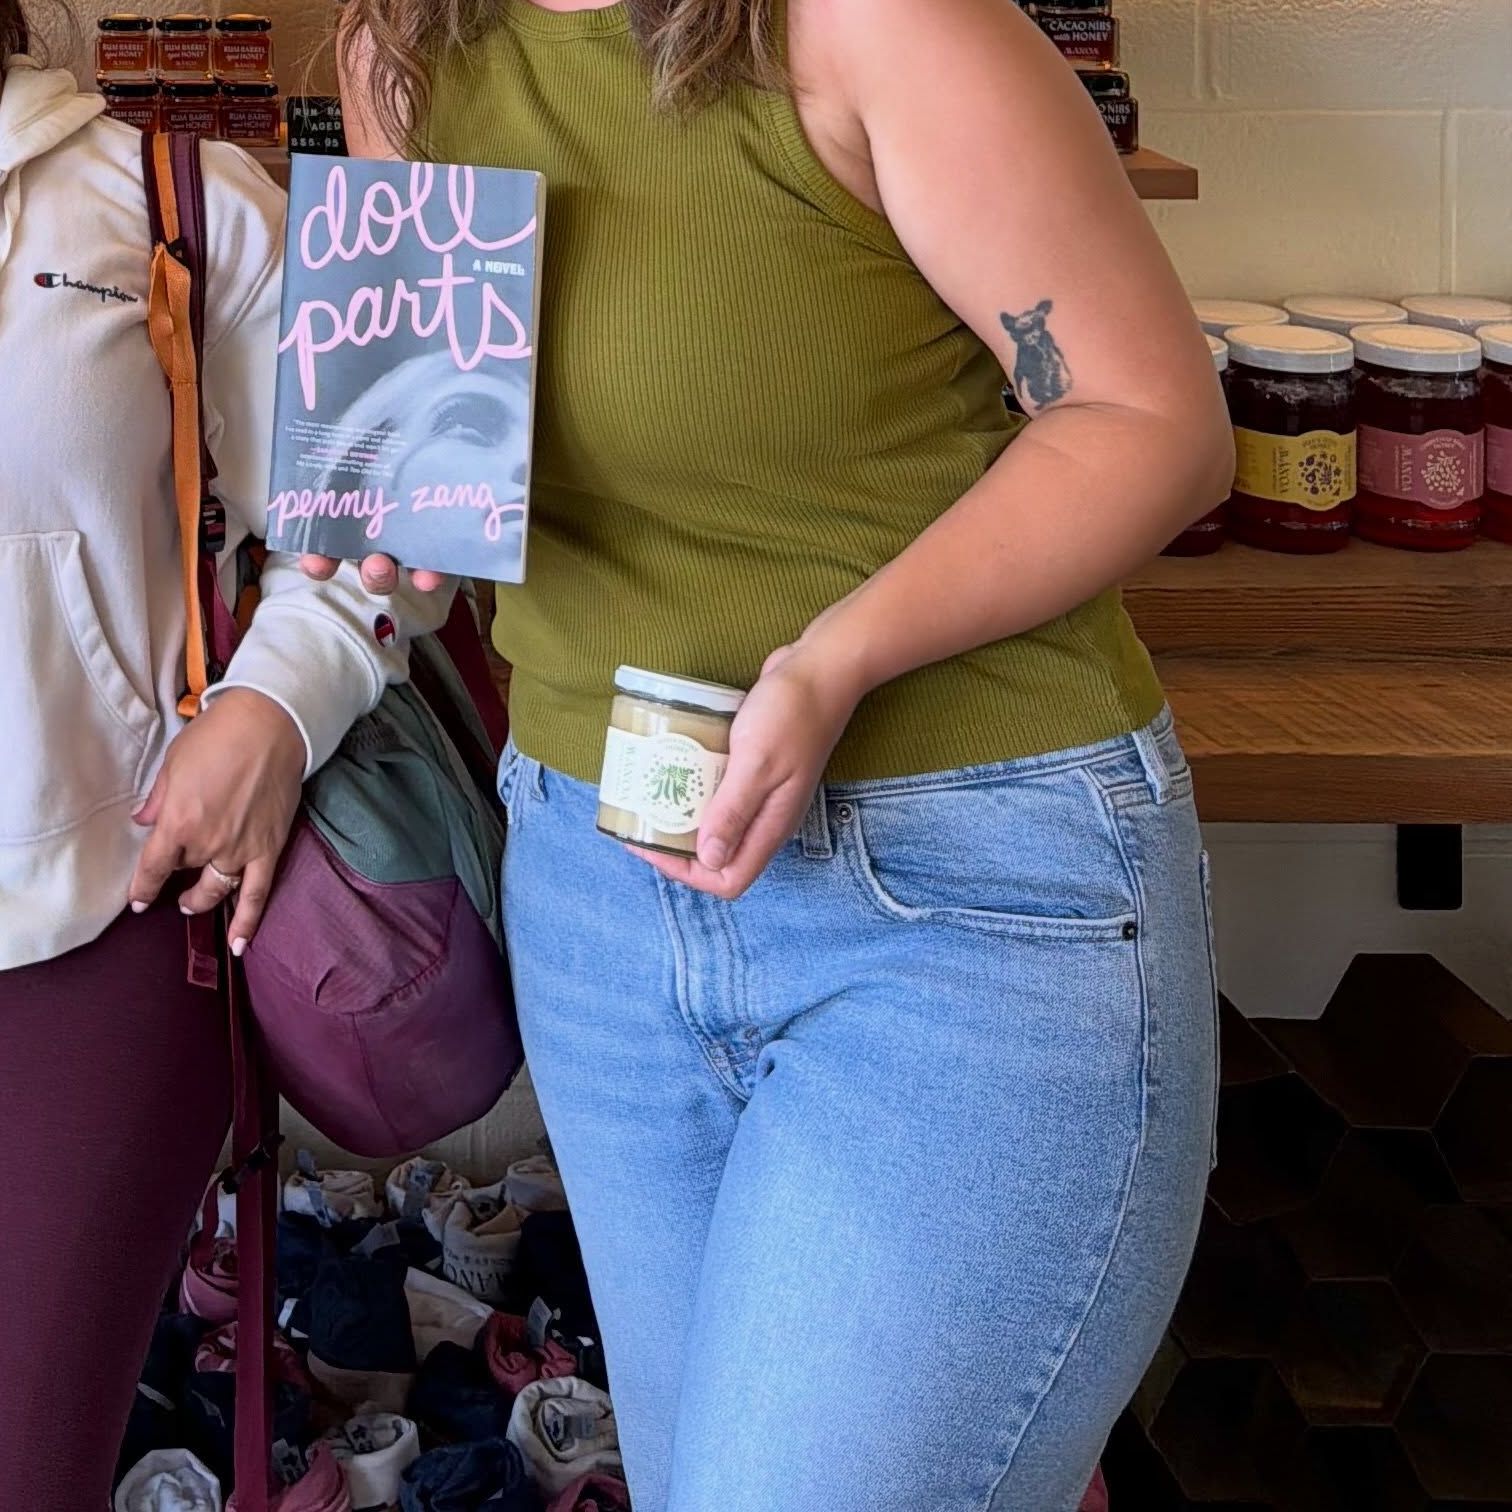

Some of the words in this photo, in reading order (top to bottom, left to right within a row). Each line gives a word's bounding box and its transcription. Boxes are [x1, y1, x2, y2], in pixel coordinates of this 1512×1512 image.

[1049, 20, 1086, 31] CACAO
[1088, 20, 1112, 31] NIBS
[1072, 31, 1108, 41] HONEY
[119, 43, 144, 51] BARREL
[1110, 103, 1130, 114] NIBS
[311, 121, 341, 131] AGED
[300, 162, 537, 270] doll
[473, 259, 482, 271] A
[485, 260, 525, 276] NOVEL
[34, 272, 138, 303] Champion
[279, 254, 532, 411] parts
[268, 486, 398, 540] penny
[411, 482, 526, 541] zang
